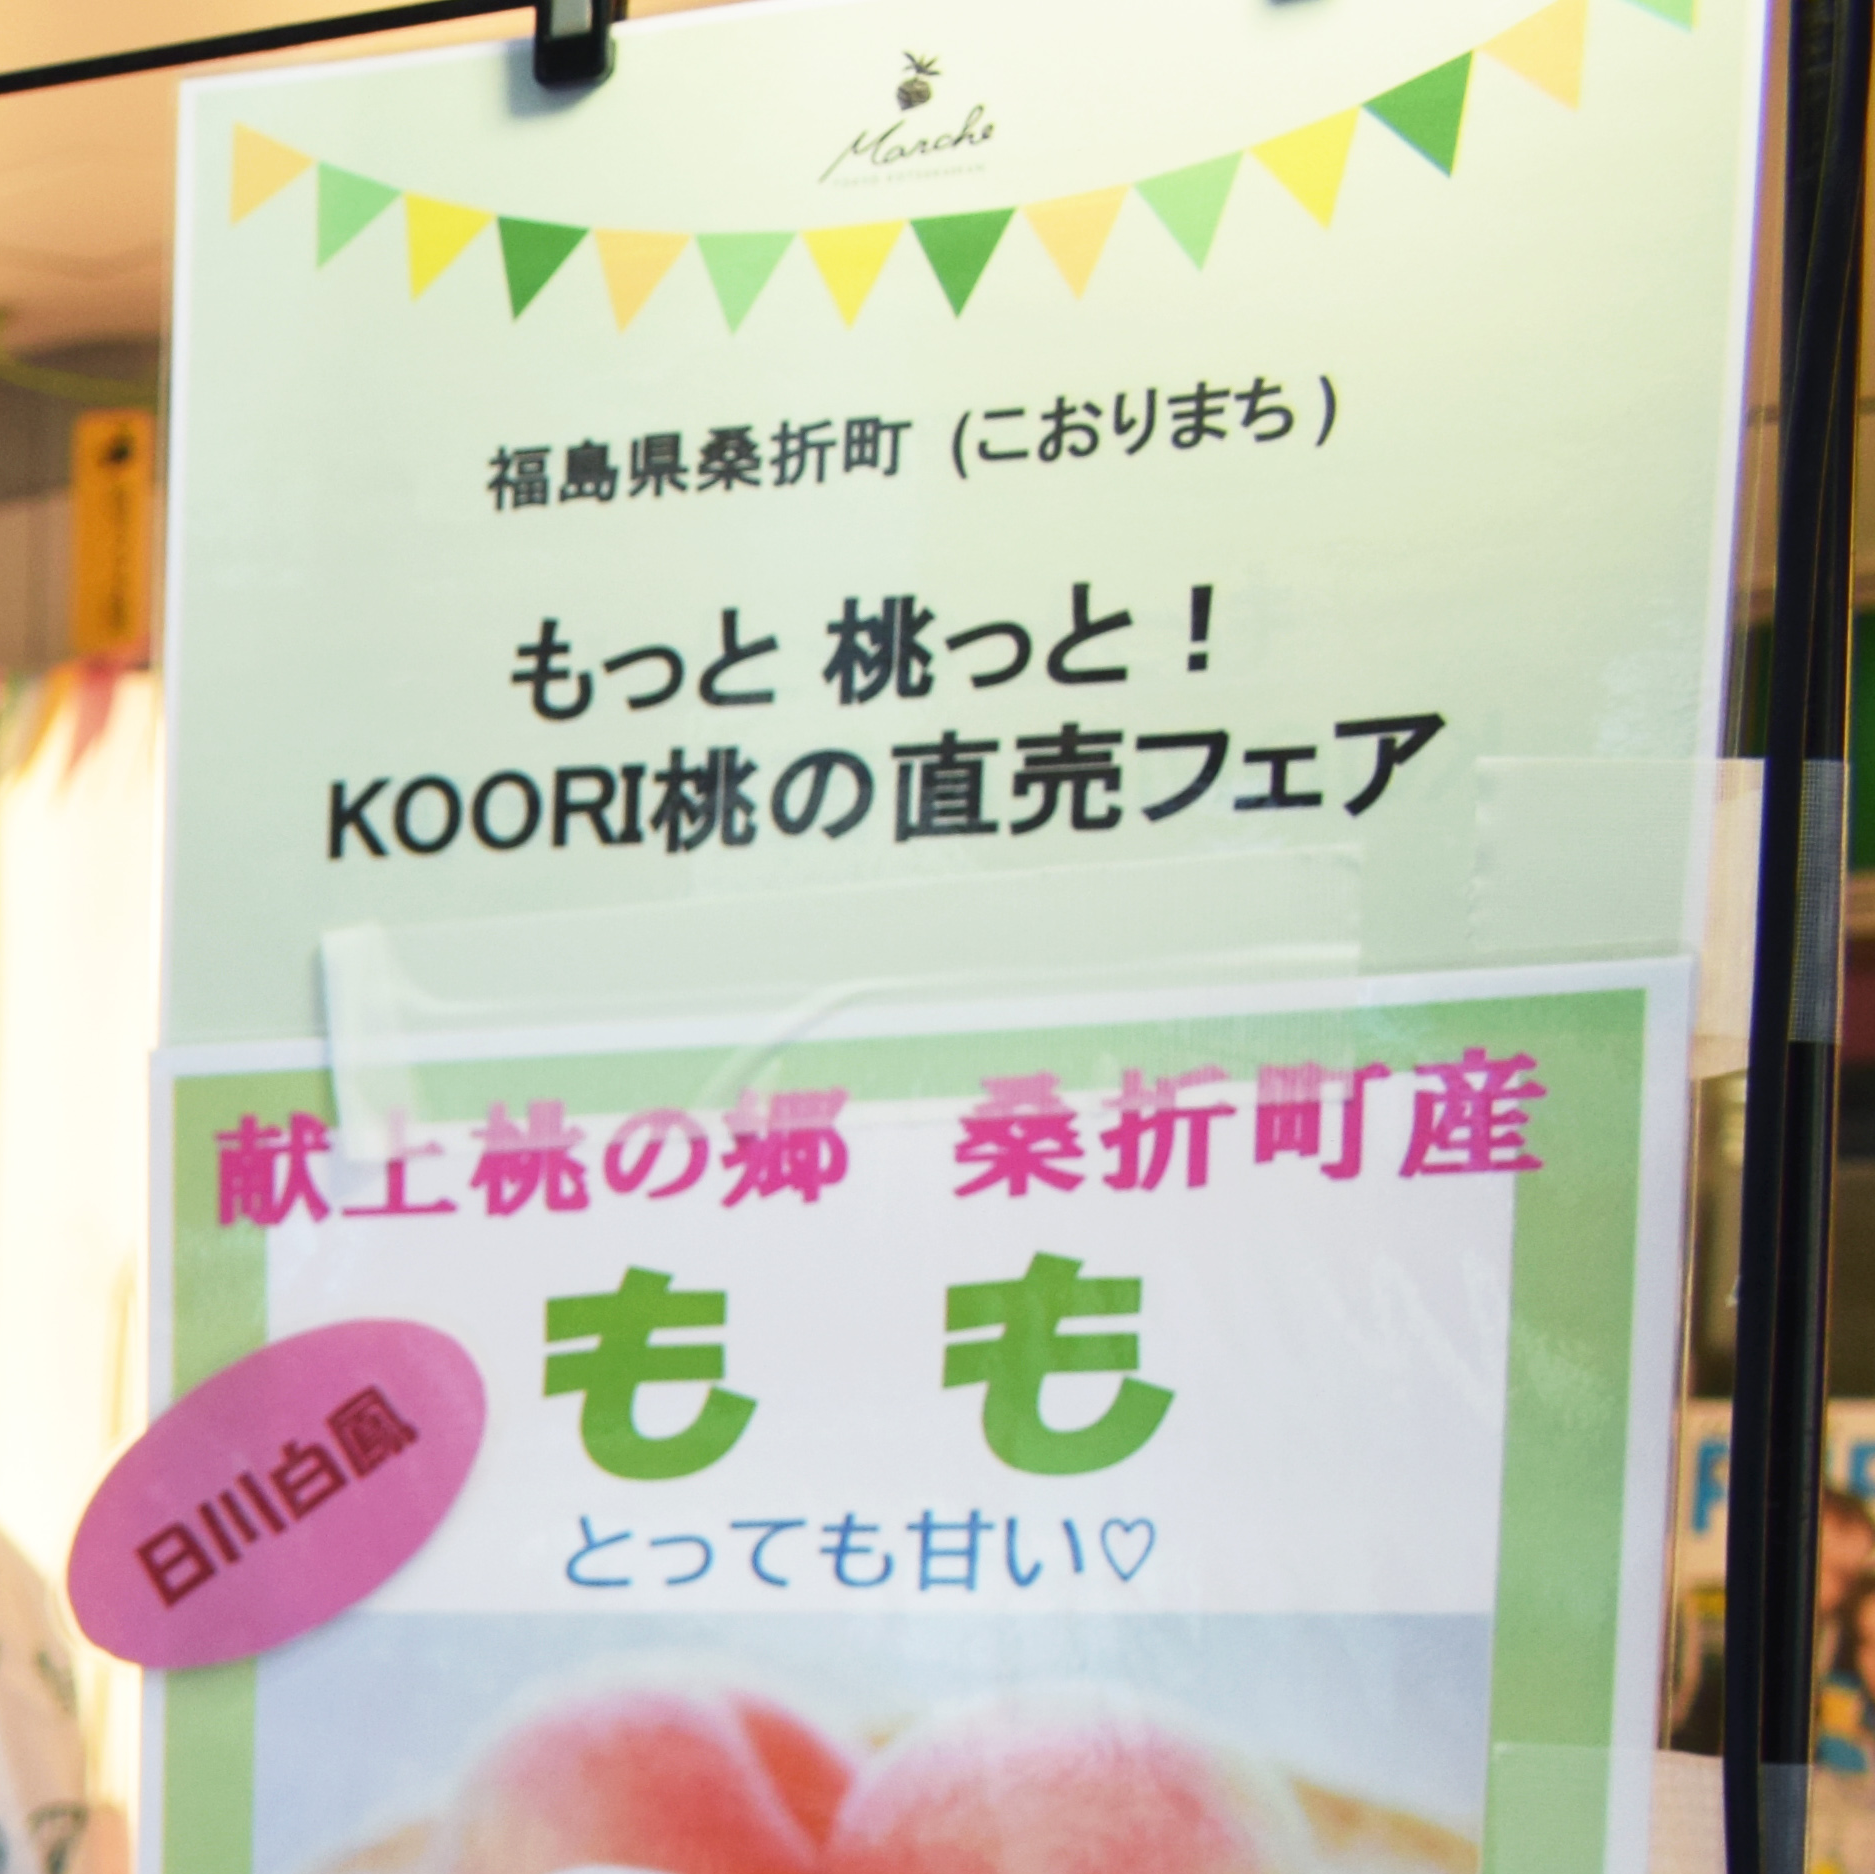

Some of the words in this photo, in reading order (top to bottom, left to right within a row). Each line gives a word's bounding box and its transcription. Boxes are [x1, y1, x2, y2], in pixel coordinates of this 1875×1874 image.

[816, 104, 995, 185] Marche
[488, 415, 913, 512] 福島県桑折町
[952, 374, 1338, 480] (こおりまち)
[510, 607, 780, 722] もっと
[326, 710, 1448, 862] KOORI桃の直売フェア
[213, 1086, 851, 1230] 献上桃の郷
[951, 1046, 1549, 1203] 桑折町産
[134, 1383, 419, 1610] 日川白鳳
